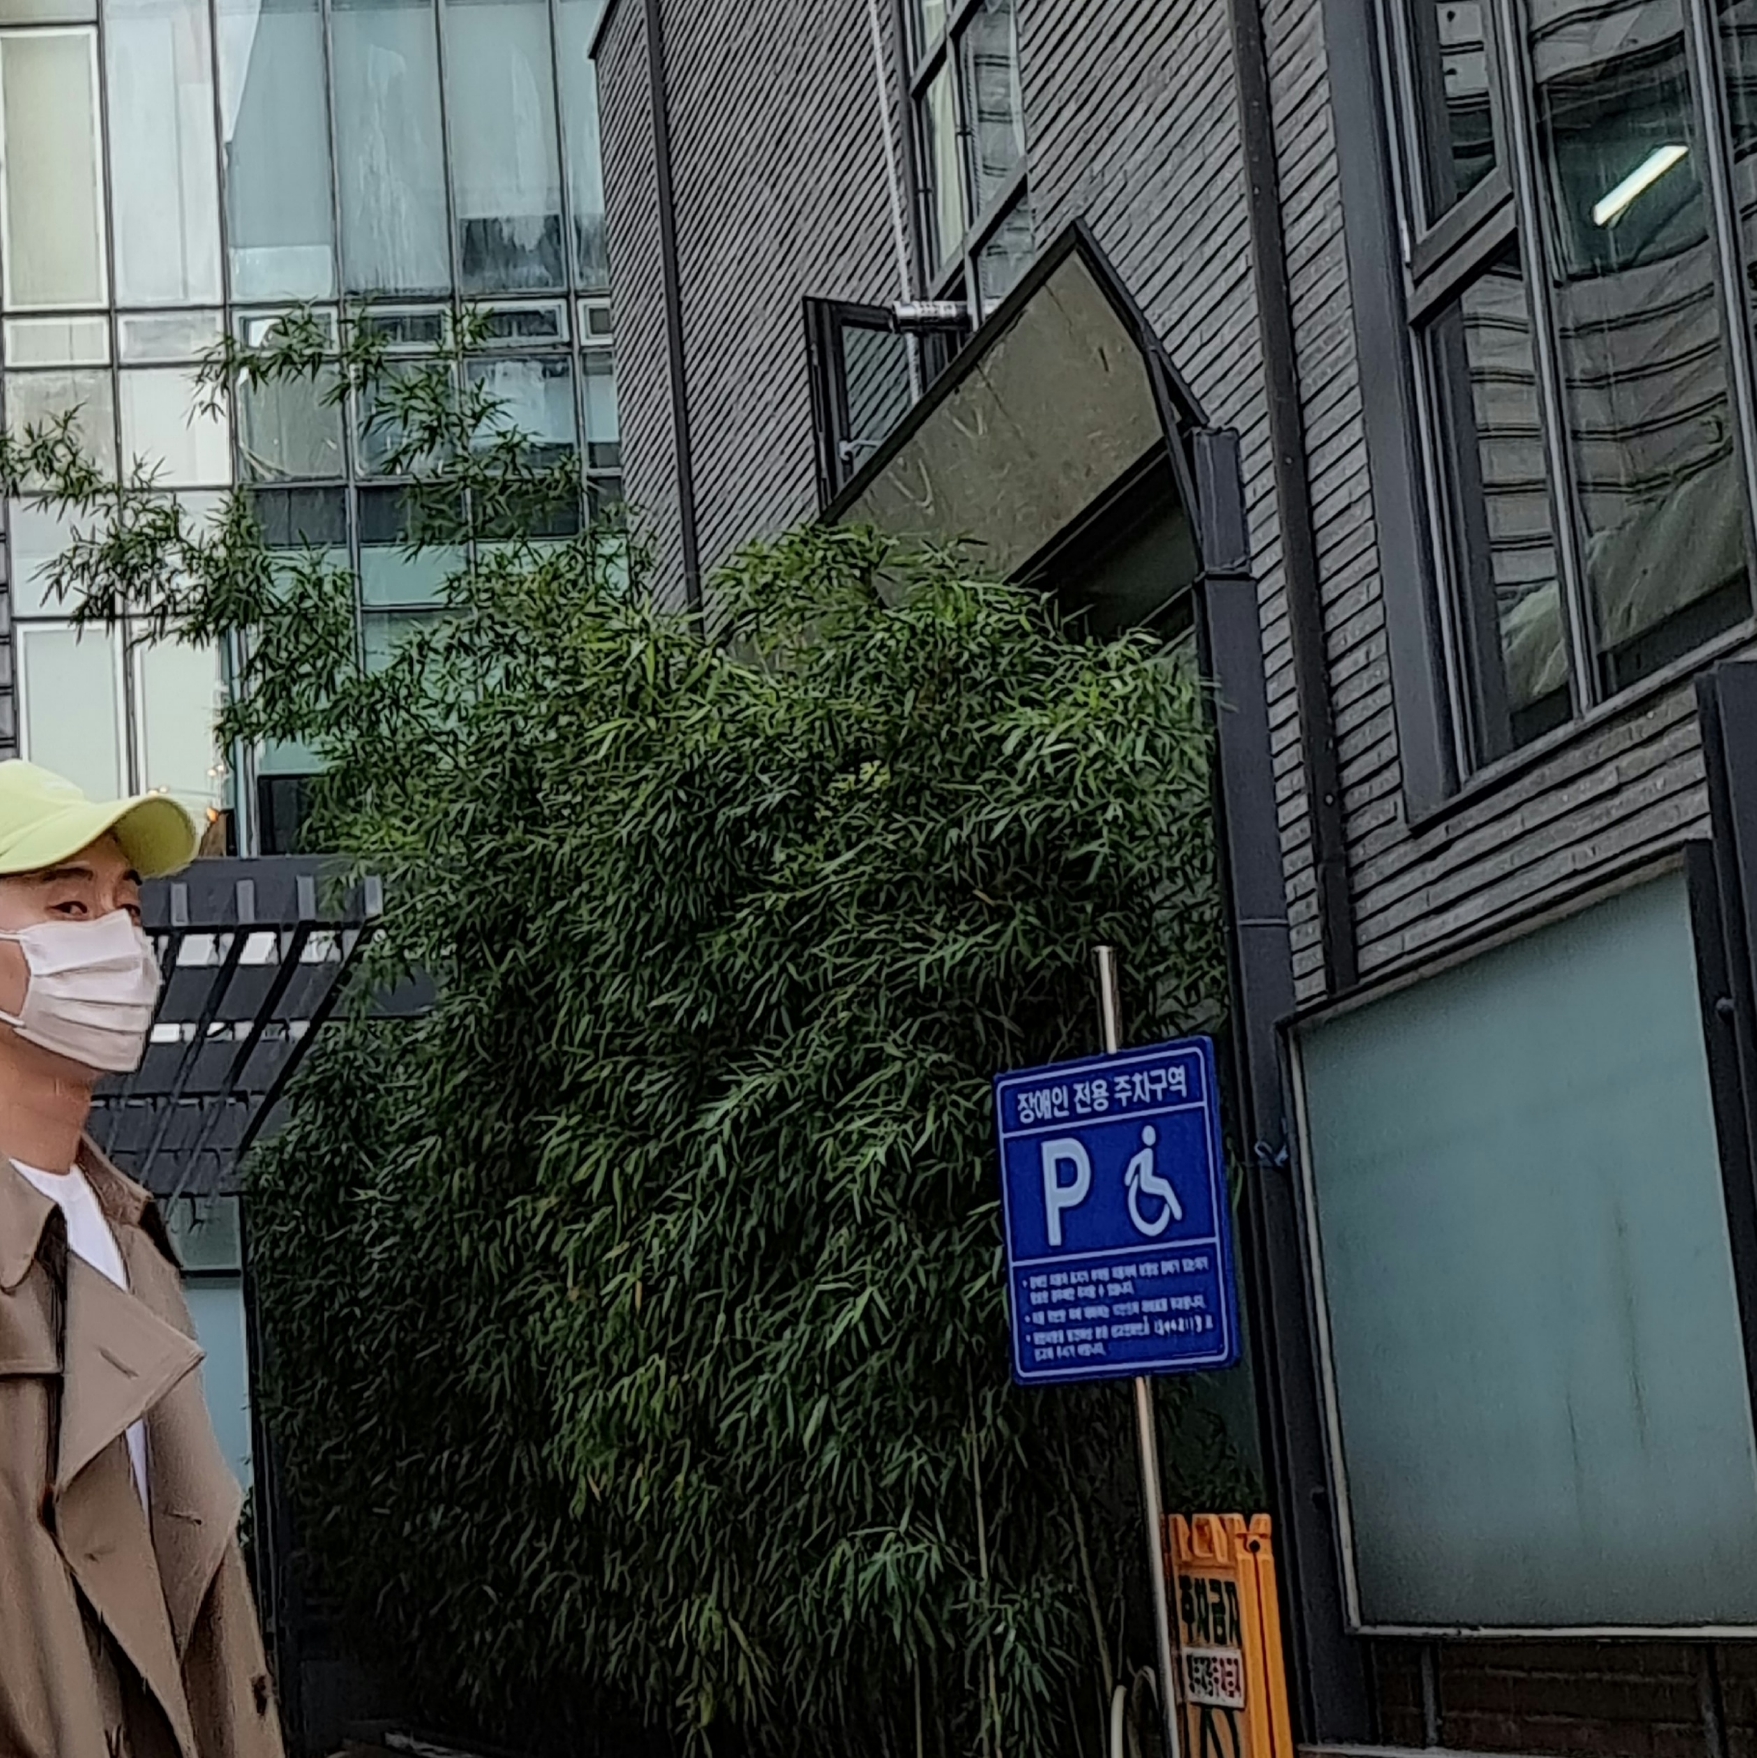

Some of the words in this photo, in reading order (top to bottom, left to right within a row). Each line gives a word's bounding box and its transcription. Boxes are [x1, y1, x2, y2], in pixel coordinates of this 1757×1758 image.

[1017, 1085, 1070, 1124] 장애인
[1073, 1079, 1110, 1114] 전용
[1114, 1065, 1188, 1107] 주차구역
[1041, 1138, 1092, 1247] P
